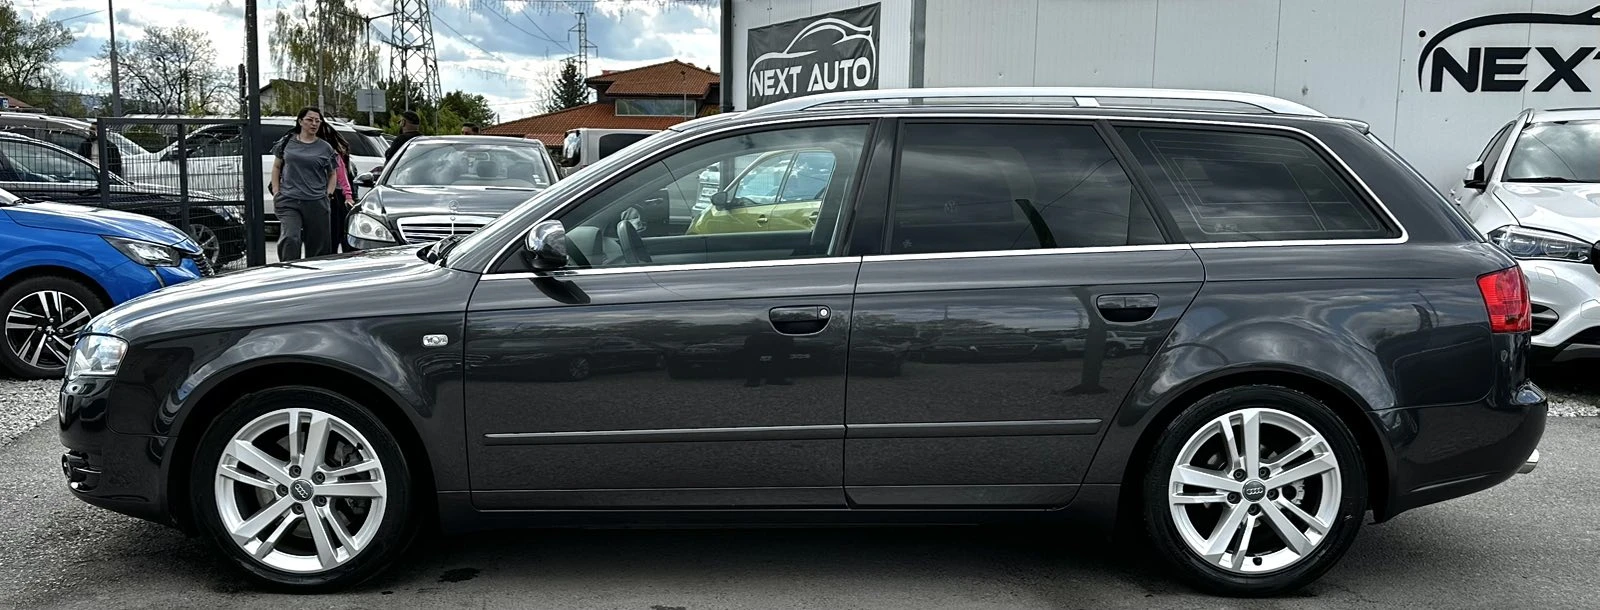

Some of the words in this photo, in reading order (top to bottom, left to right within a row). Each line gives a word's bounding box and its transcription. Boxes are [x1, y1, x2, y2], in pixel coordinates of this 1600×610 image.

[752, 66, 802, 97] NEXT
[807, 57, 871, 92] AUTO
[1430, 47, 1600, 93] NEX
